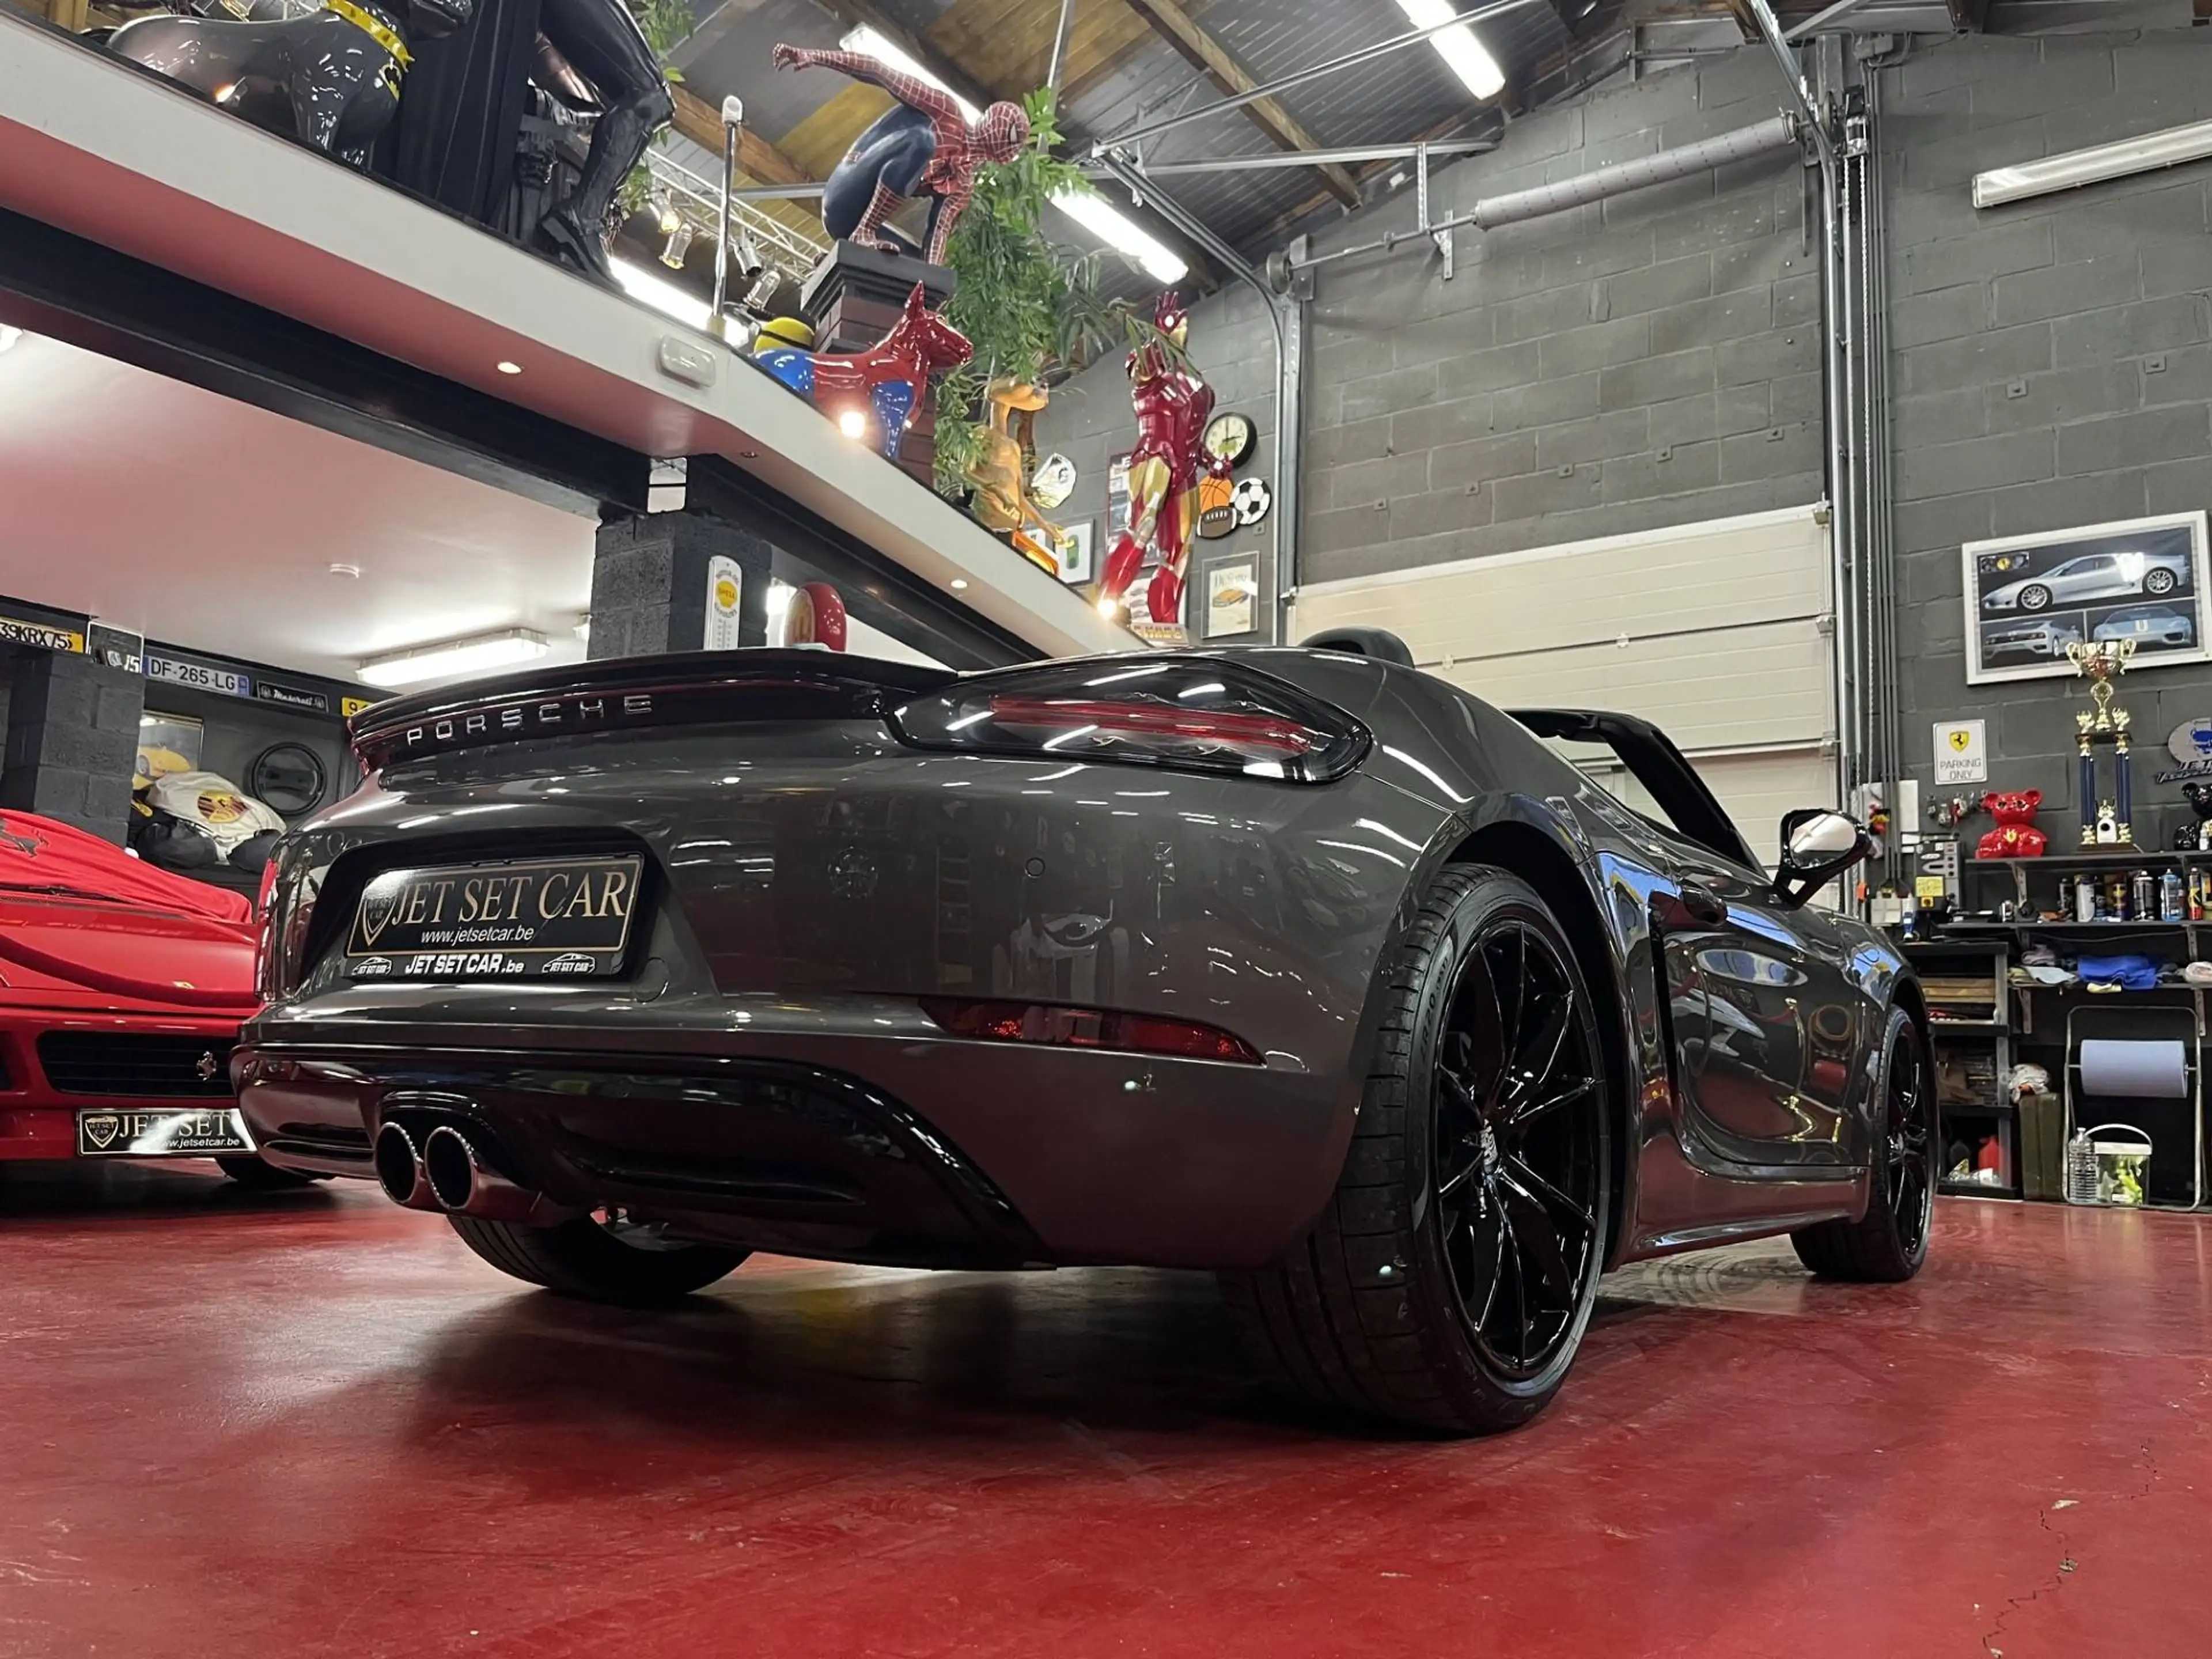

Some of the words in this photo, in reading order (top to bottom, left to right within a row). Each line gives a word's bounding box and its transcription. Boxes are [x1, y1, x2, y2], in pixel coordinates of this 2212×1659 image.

[407, 695, 653, 745] PORSCHE
[1940, 758, 1982, 770] PARKING
[1949, 770, 1973, 781] ONLY
[392, 881, 455, 926] JET
[458, 876, 533, 923] SET
[538, 872, 627, 920] CAR
[421, 925, 534, 946] www.jetsetcar.be
[405, 955, 433, 975] JET
[434, 954, 468, 974] SET
[465, 953, 525, 974] CAR.be
